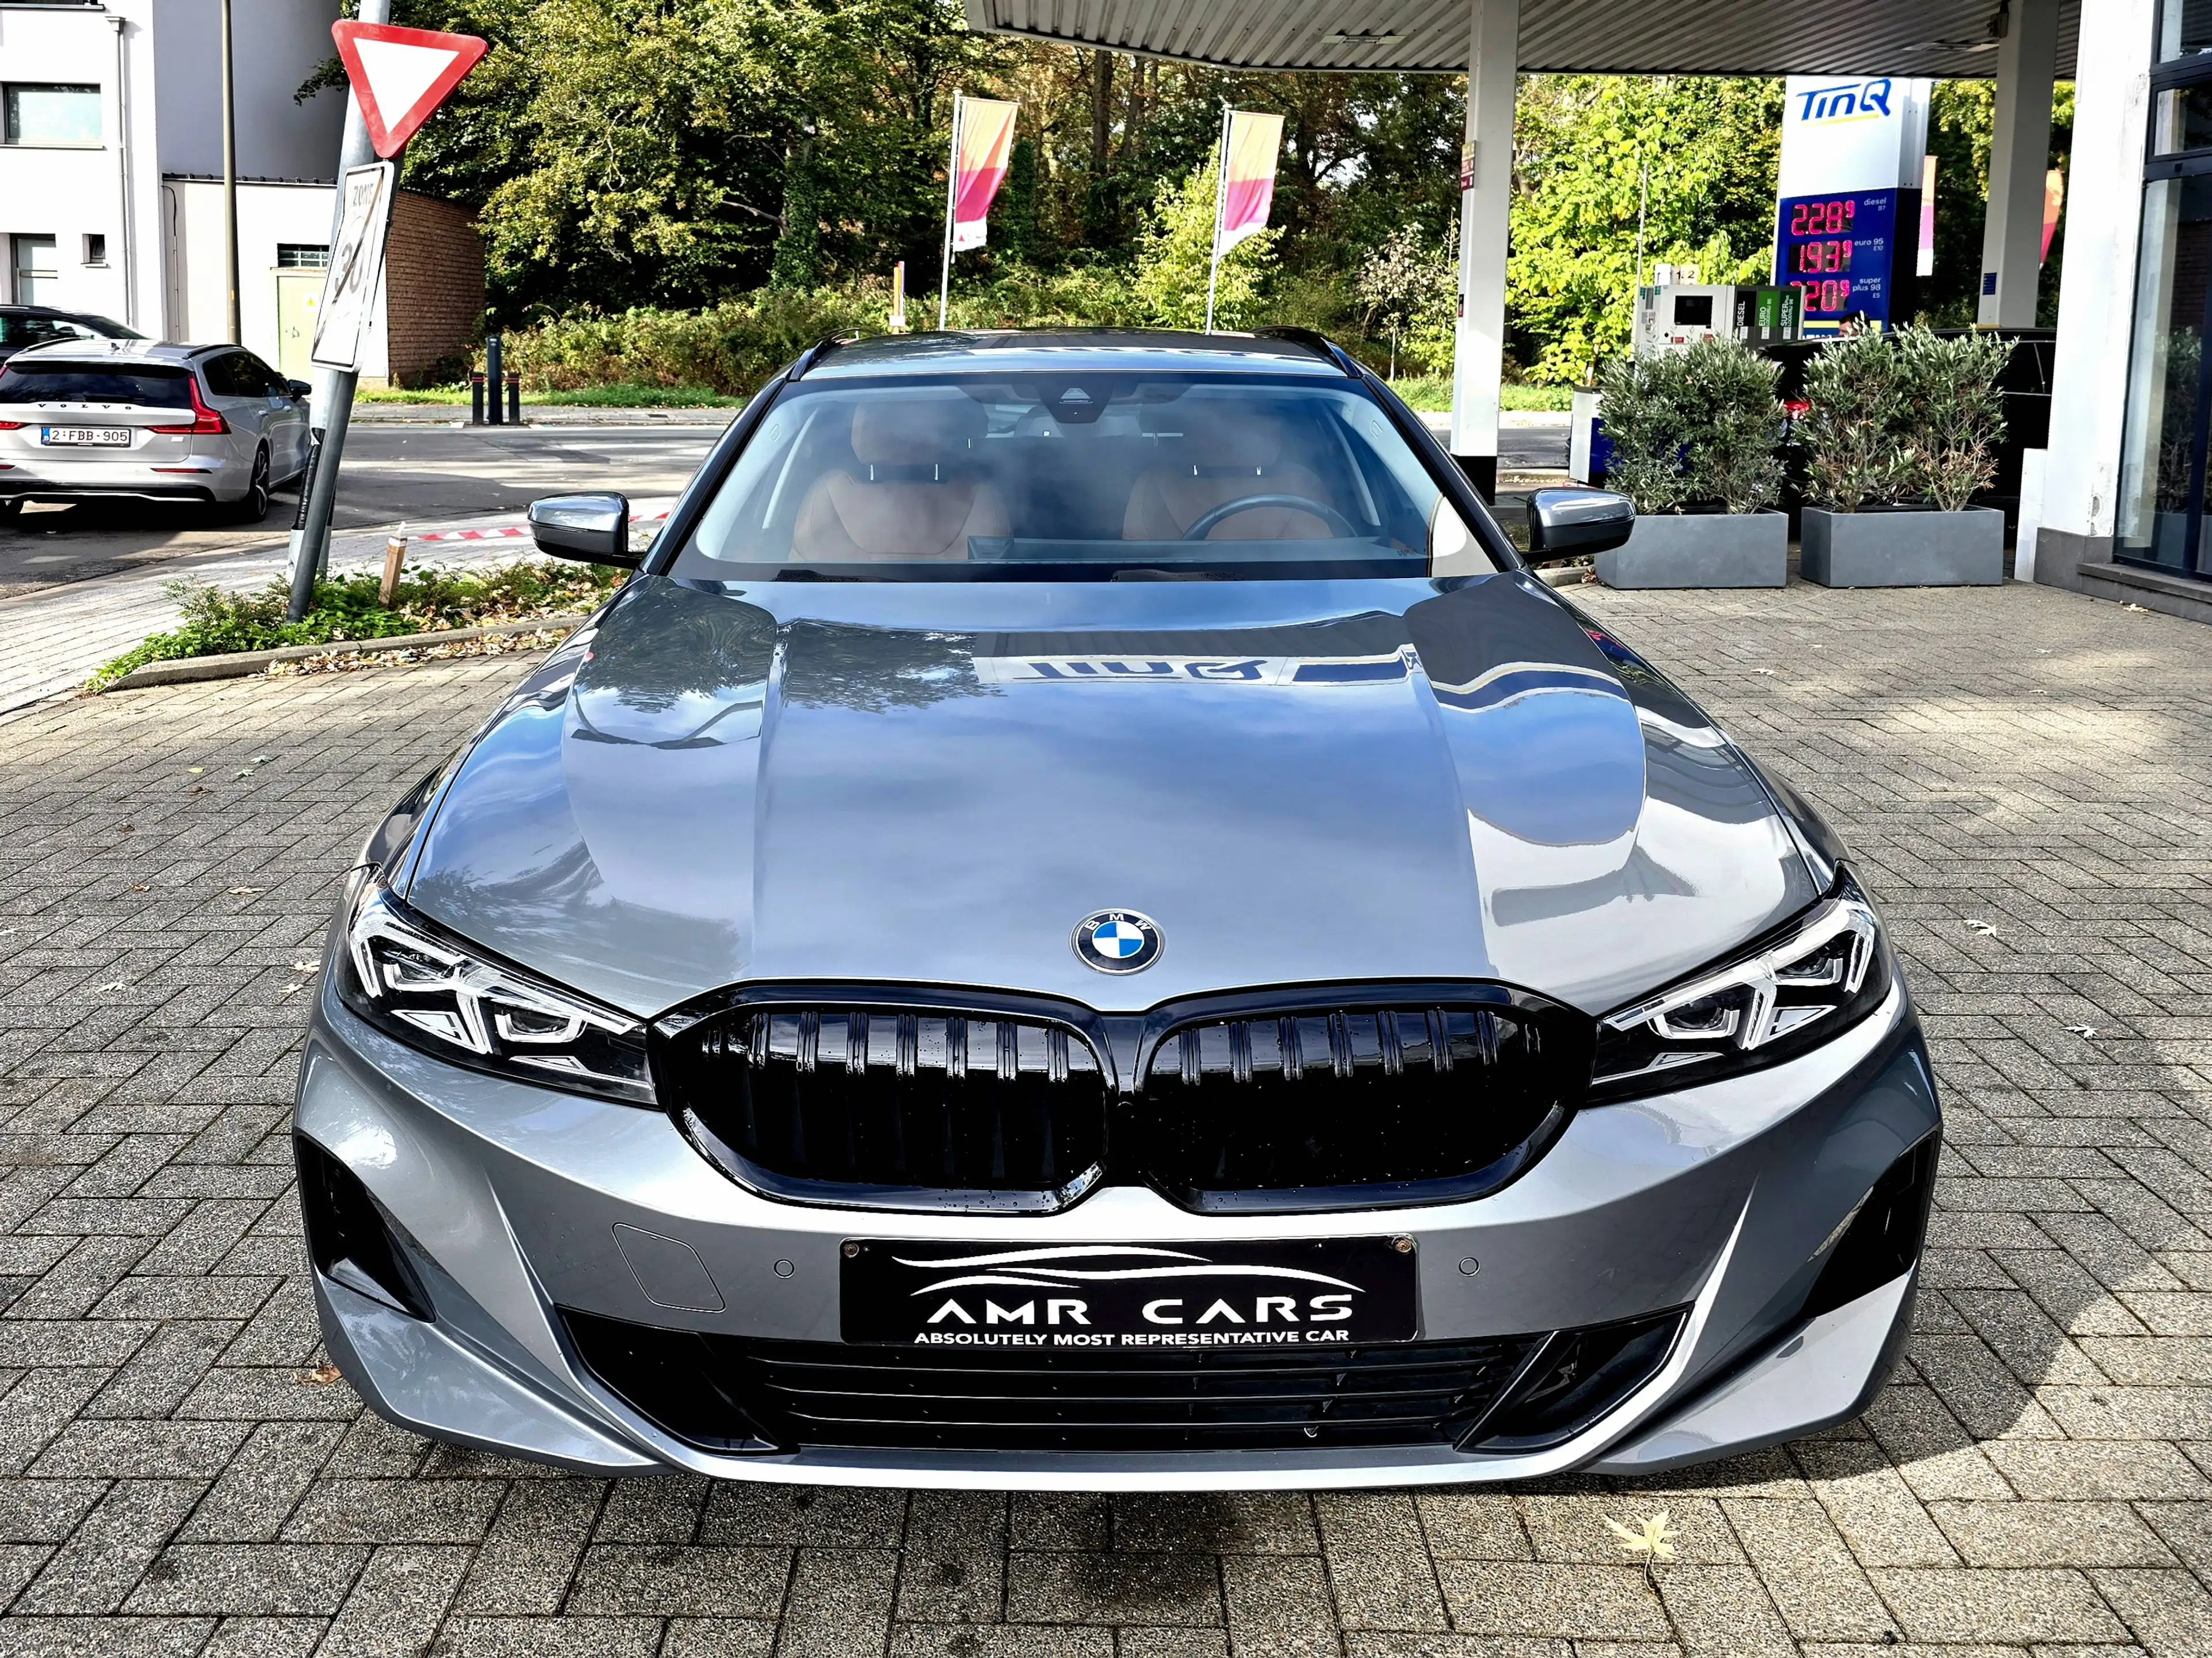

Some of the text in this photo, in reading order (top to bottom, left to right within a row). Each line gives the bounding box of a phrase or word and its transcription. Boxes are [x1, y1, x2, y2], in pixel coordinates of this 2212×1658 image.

[1863, 197, 1887, 206] diesel
[335, 242, 364, 294] 30
[1859, 277, 1881, 285] super
[1737, 301, 1745, 326] DIESEL
[1084, 913, 1152, 931] BMW
[926, 1294, 1353, 1325] AMR CARS
[914, 1330, 1349, 1346] ABSOLUTELY MOST REPRESENTATIVE CAR
